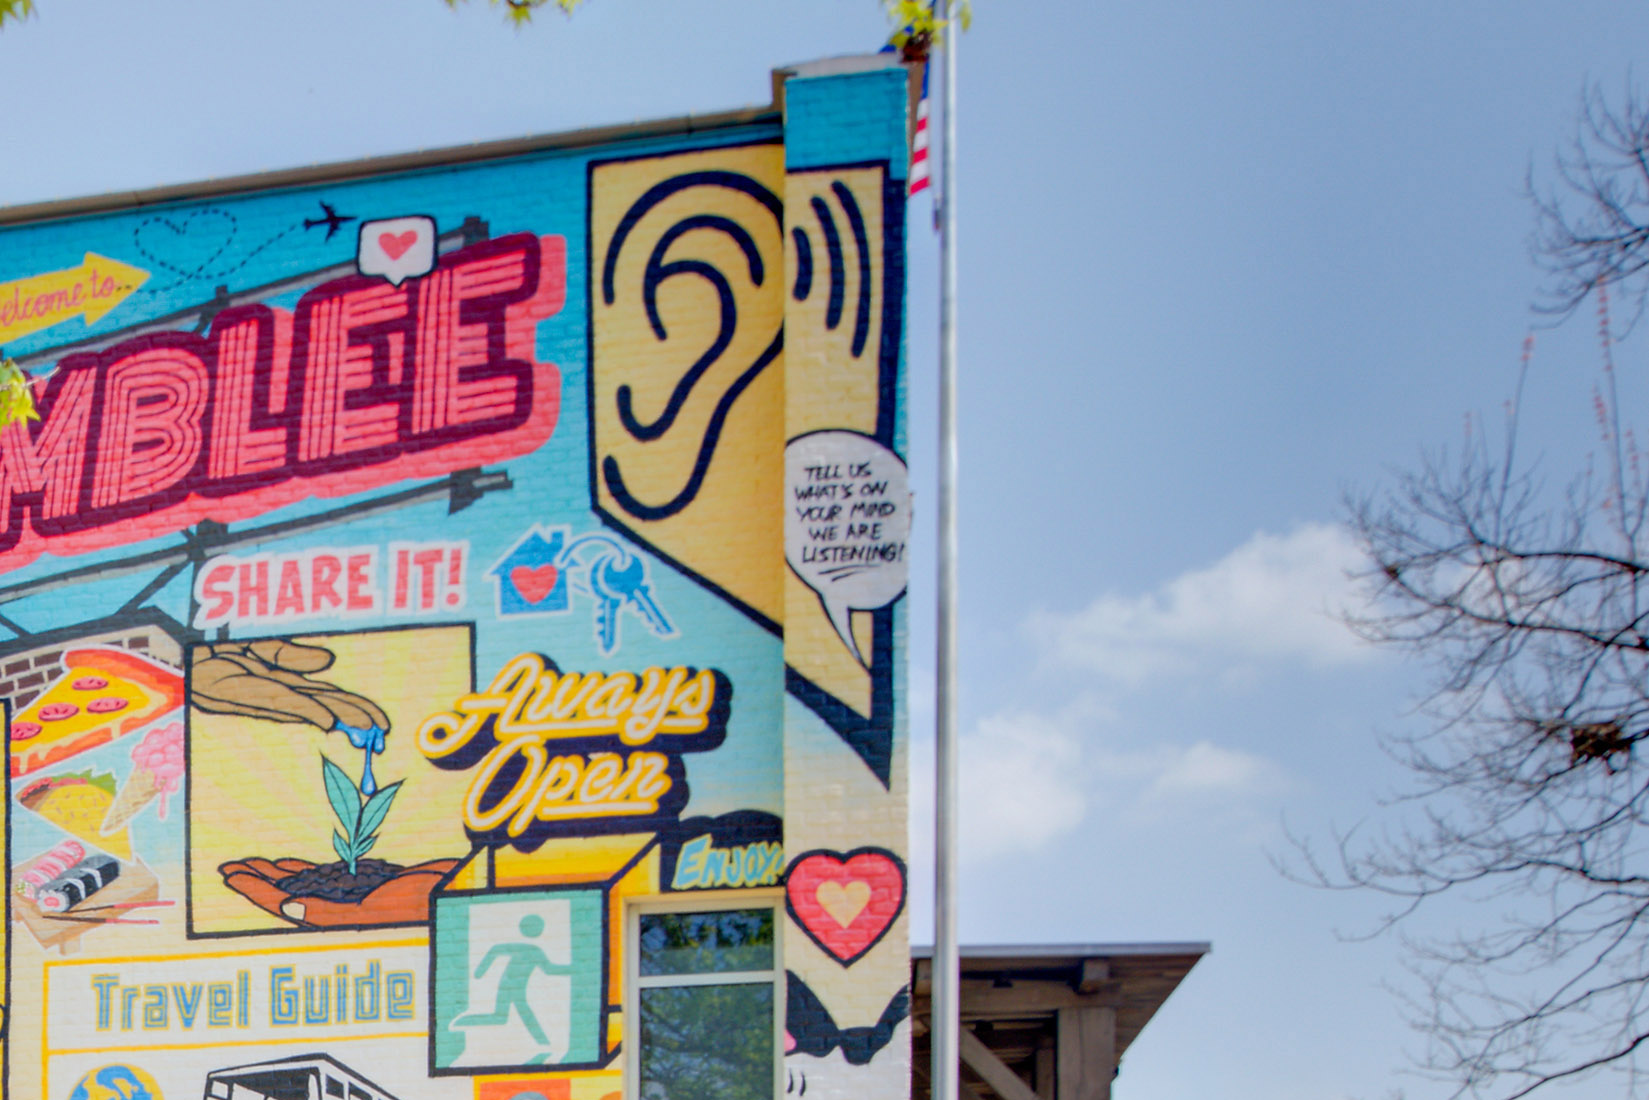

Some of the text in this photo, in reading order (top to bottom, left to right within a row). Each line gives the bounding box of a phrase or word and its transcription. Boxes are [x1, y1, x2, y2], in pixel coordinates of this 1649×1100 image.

[89, 268, 115, 298] to
[803, 461, 873, 481] TELL US
[795, 480, 889, 500] WHAT'S ON
[795, 501, 897, 522] YOUR MIND
[808, 522, 883, 541] WE ARE
[802, 541, 906, 563] LISTENING!
[201, 548, 463, 620] SHARE IT!
[462, 733, 672, 838] Open
[90, 958, 416, 1033] Travel Guide
